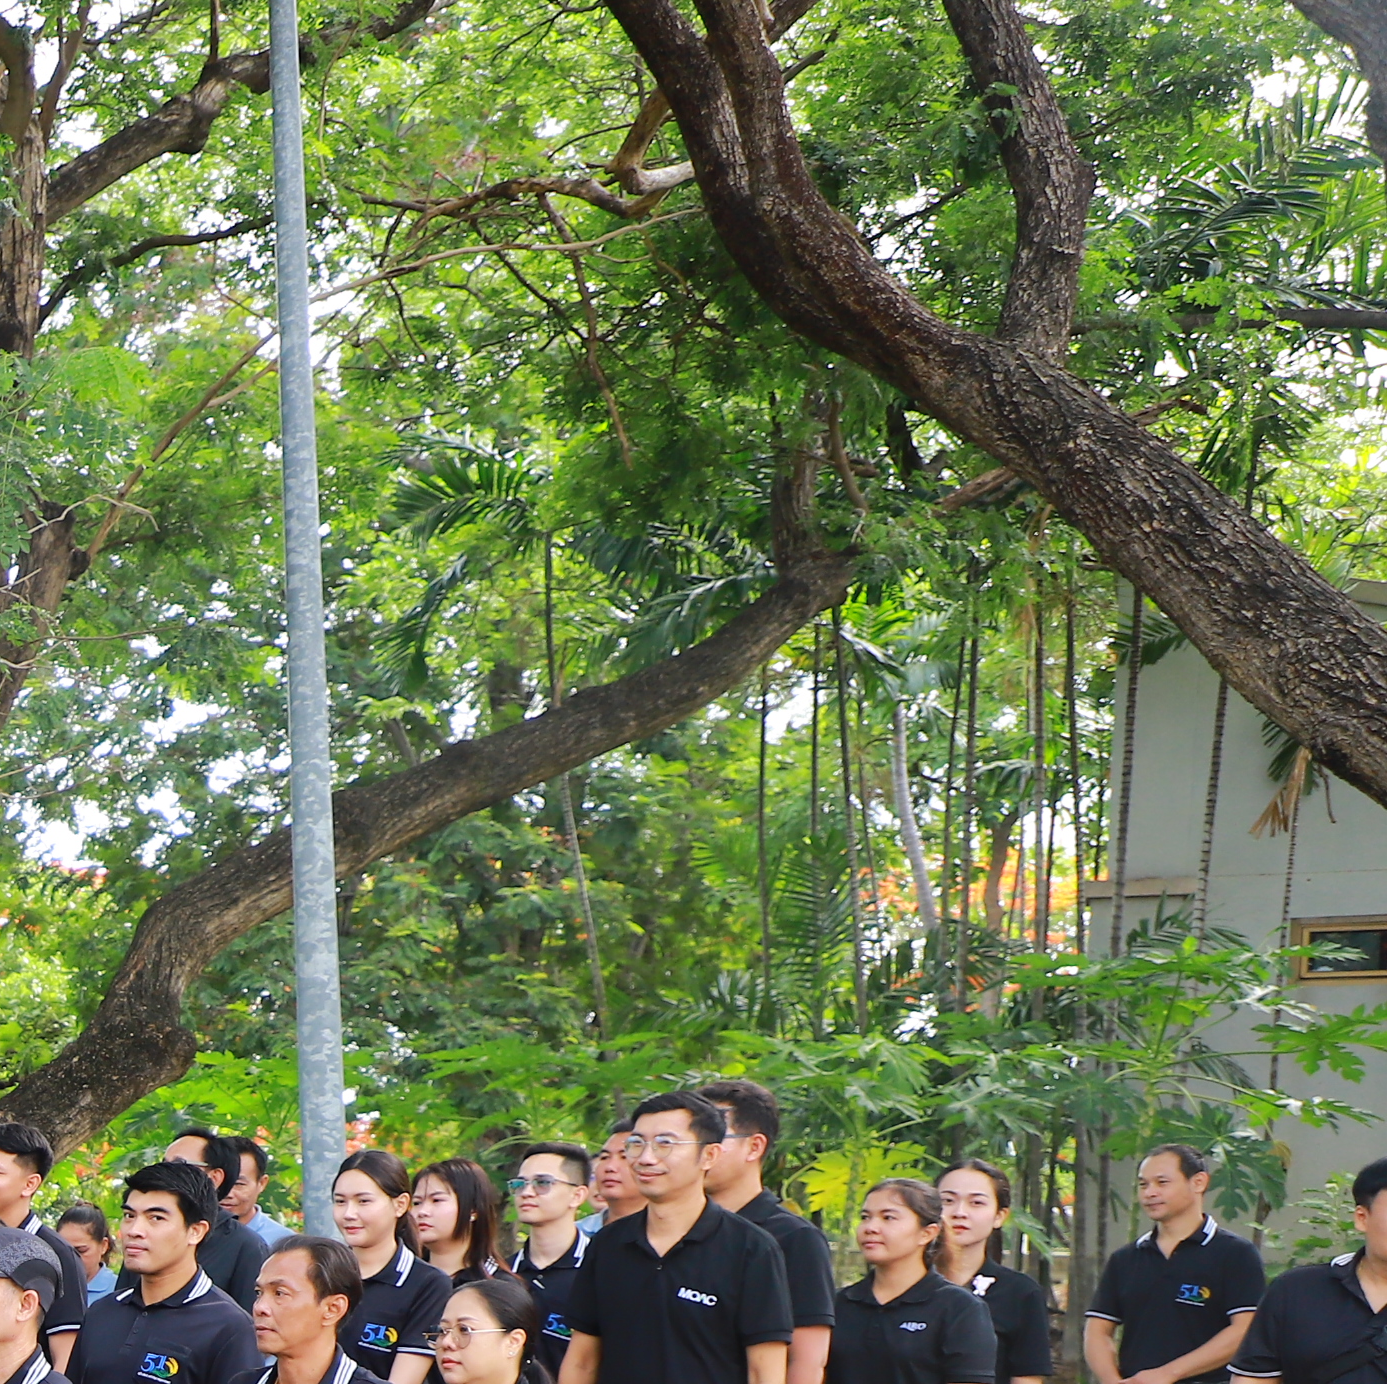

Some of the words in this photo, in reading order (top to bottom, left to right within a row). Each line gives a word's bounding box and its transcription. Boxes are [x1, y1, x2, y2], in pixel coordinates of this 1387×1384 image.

[677, 1287, 718, 1306] MOAC
[1178, 1284, 1200, 1298] 51
[361, 1323, 386, 1342] 51
[140, 1352, 167, 1372] 51
